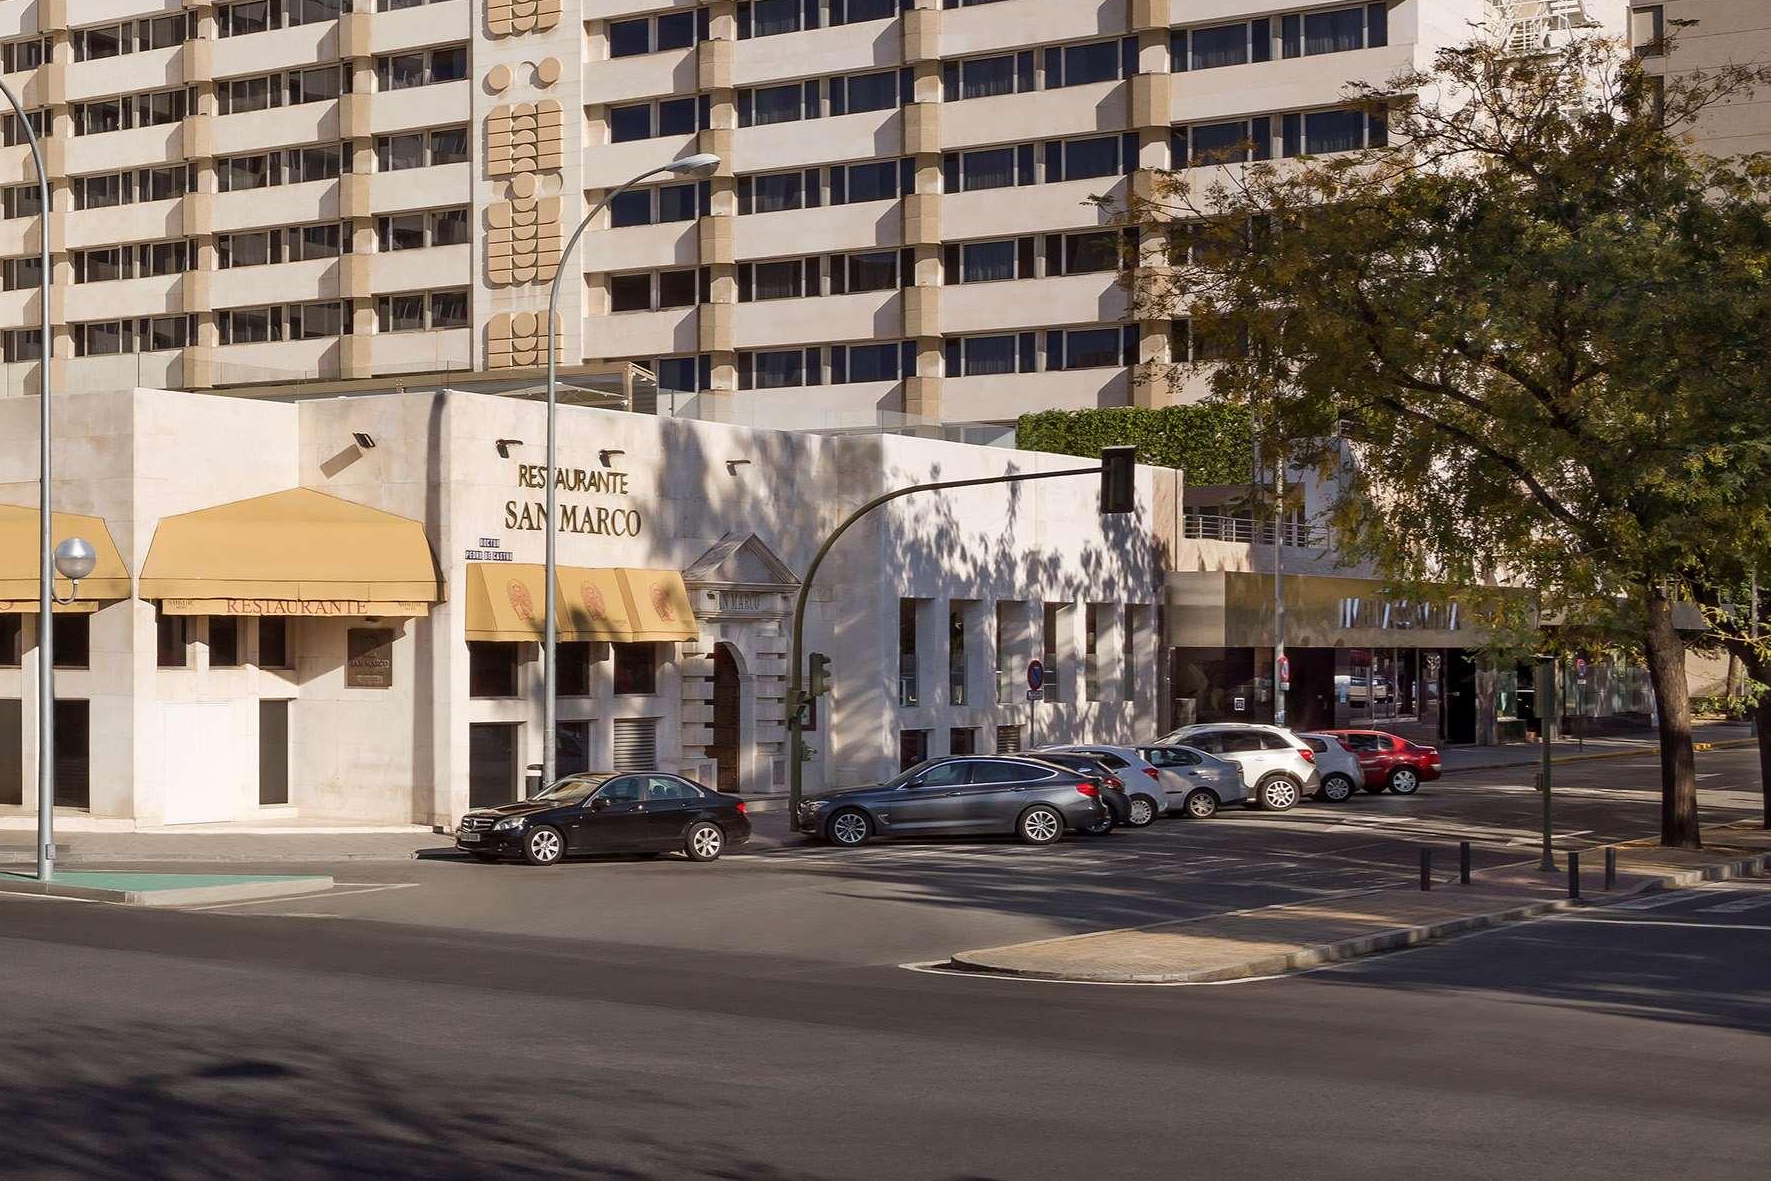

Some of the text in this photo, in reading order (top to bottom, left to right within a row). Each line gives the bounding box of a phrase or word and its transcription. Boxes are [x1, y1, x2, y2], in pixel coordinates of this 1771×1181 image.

[518, 464, 629, 495] RESAURANTE
[558, 504, 642, 537] MARCO
[227, 599, 368, 615] RESTAURANTE
